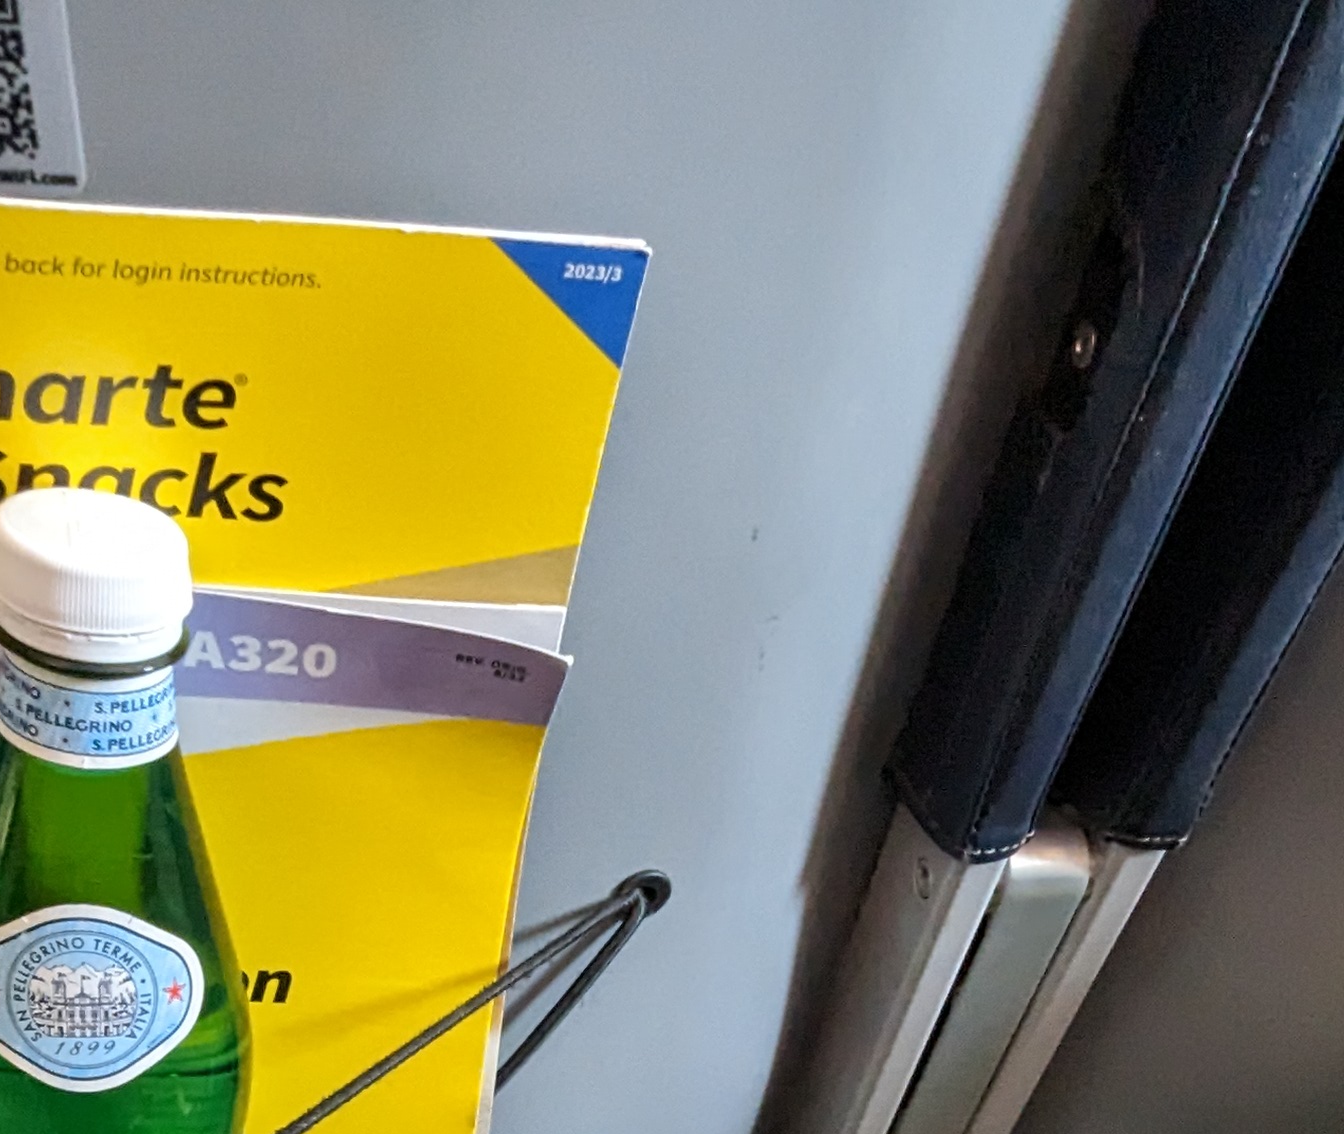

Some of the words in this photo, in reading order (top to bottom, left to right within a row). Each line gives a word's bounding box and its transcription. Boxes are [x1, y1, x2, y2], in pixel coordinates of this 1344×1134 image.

[5, 251, 64, 278] back
[73, 256, 106, 279] for
[112, 258, 172, 286] login
[179, 261, 322, 290] instructions.
[563, 263, 623, 284] 2023/3
[183, 629, 338, 680] A320
[13, 937, 85, 1002] PELLEGRINO
[93, 938, 142, 974] TERME
[16, 1010, 43, 1042] SAN
[125, 993, 152, 1041] ITALIA
[54, 1040, 116, 1056] 1899
